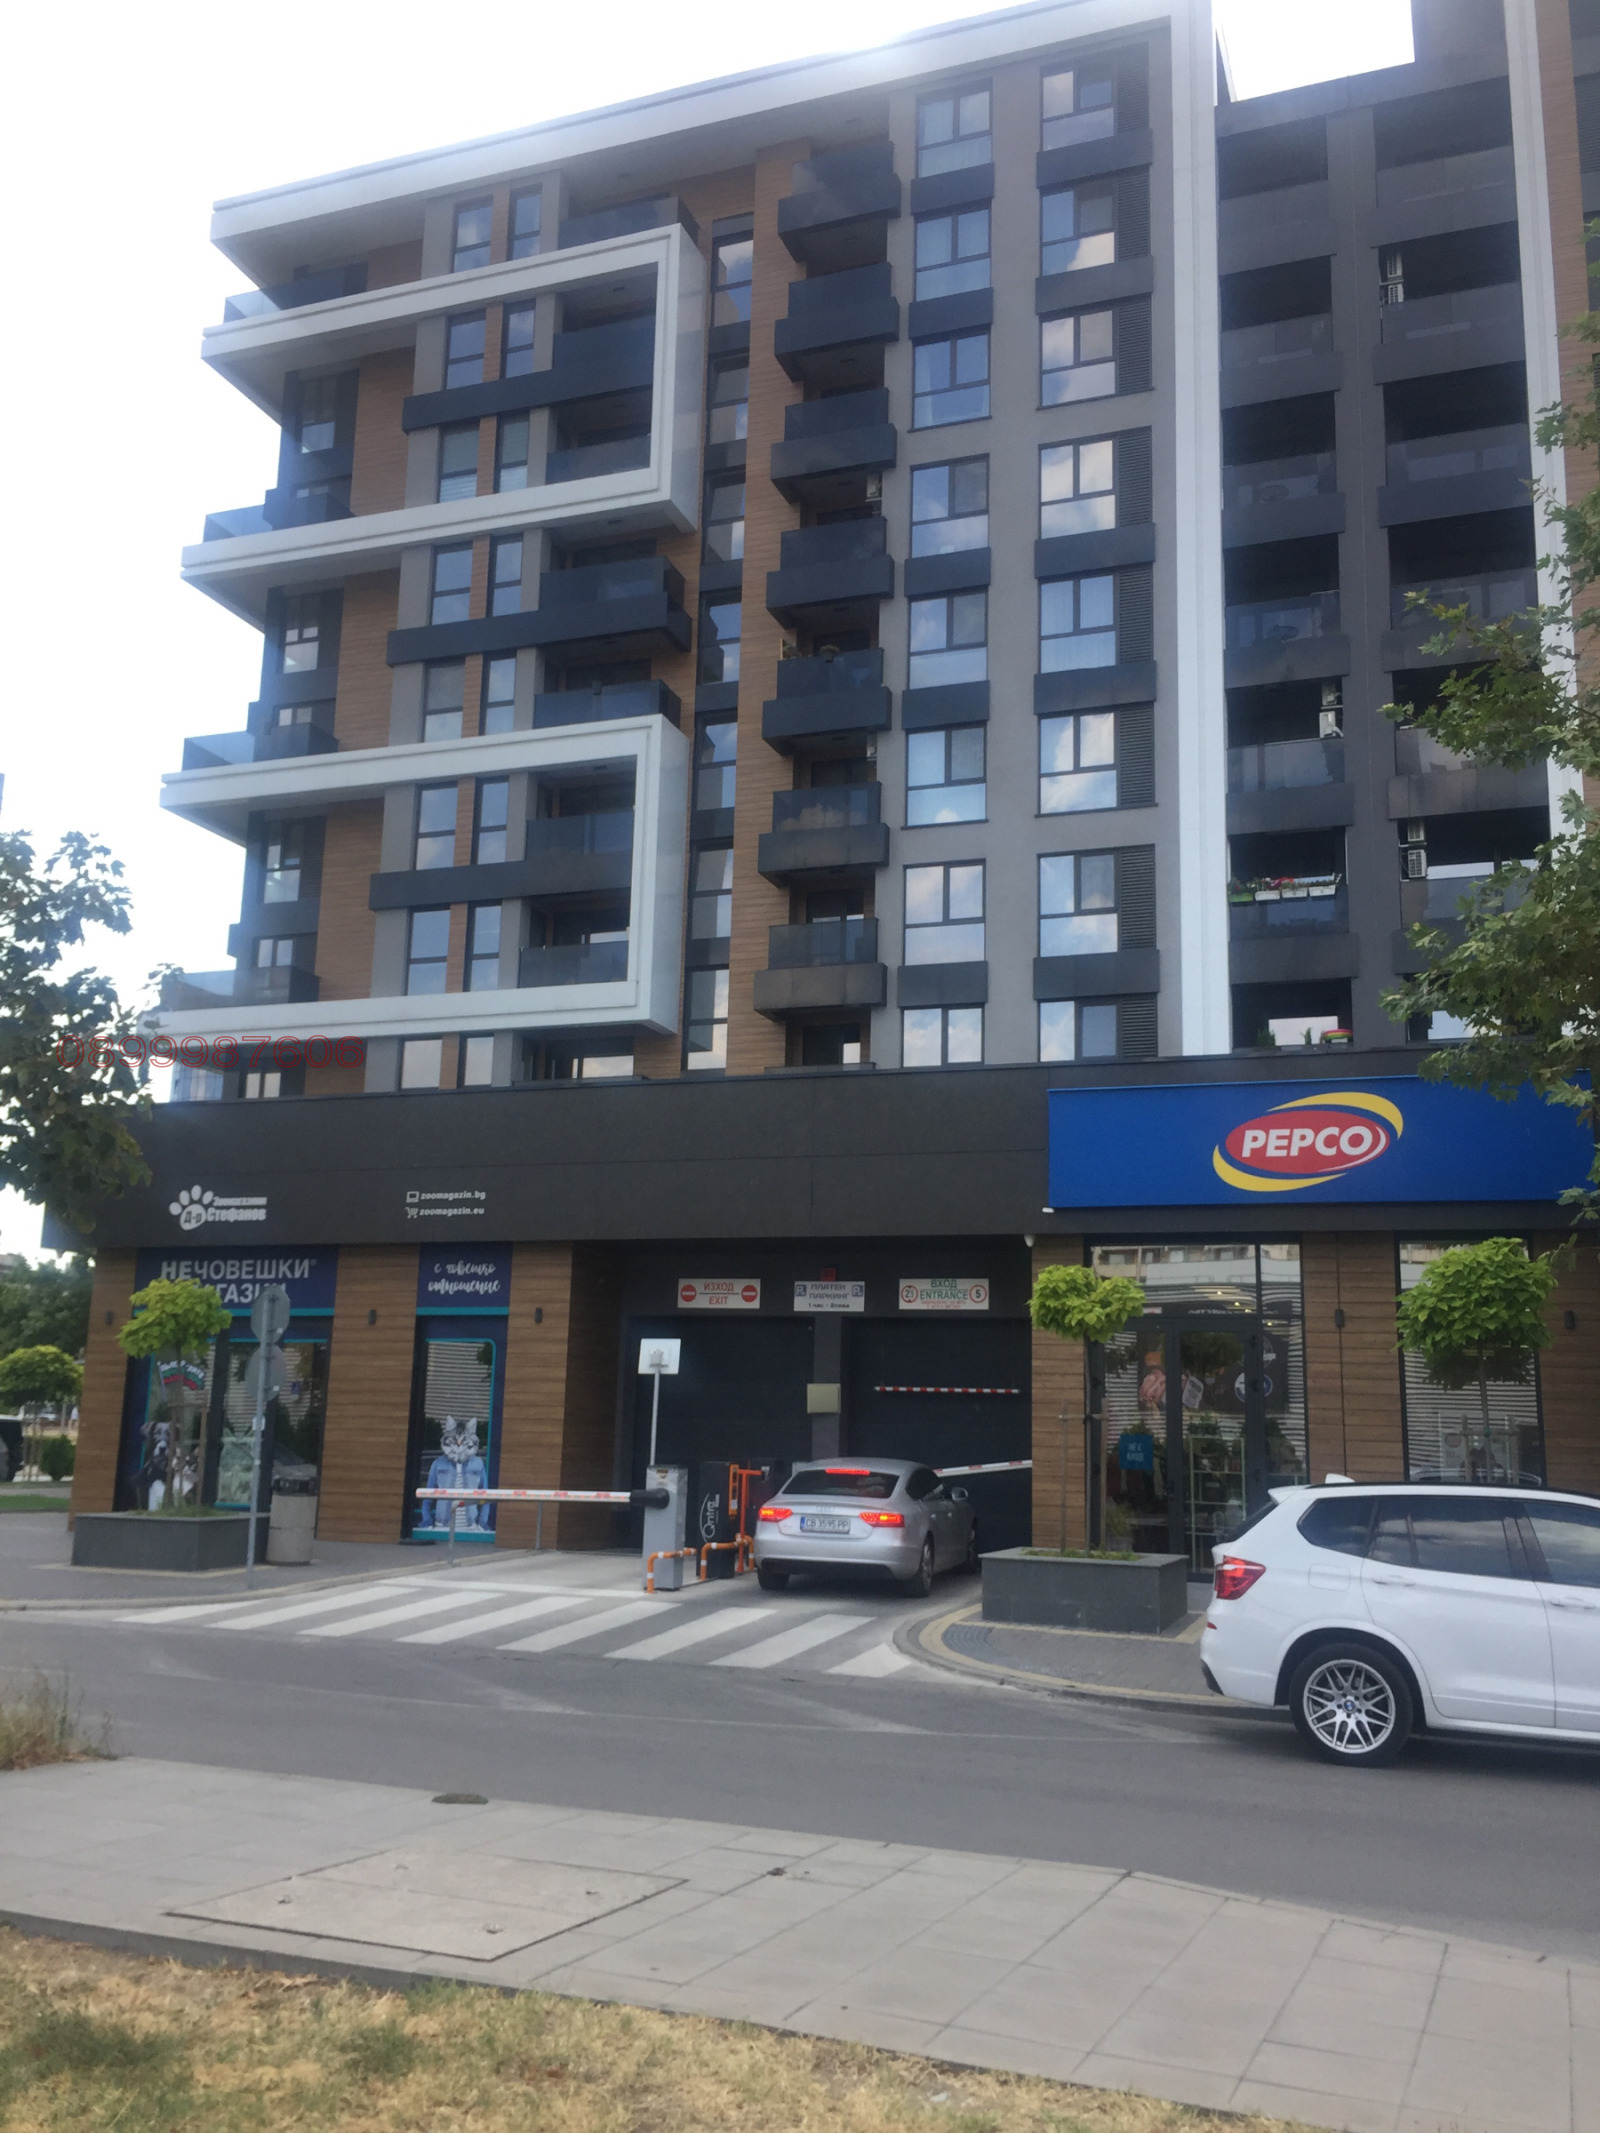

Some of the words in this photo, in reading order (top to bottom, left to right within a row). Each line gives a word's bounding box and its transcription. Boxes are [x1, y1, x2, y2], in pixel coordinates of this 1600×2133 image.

[1242, 1125, 1373, 1158] PEPCO
[420, 1190, 486, 1201] zoomagazin.bg
[207, 1207, 267, 1222] Стефанов
[419, 1206, 485, 1217] zoomagazin.eu
[704, 1282, 735, 1292] ИЗХОД
[811, 1283, 846, 1291] ПЛАТЕН
[931, 1279, 958, 1288] ВХОД
[920, 1290, 969, 1300] ENTRANCE
[975, 1289, 982, 1299] 5
[709, 1296, 728, 1305] EXIT
